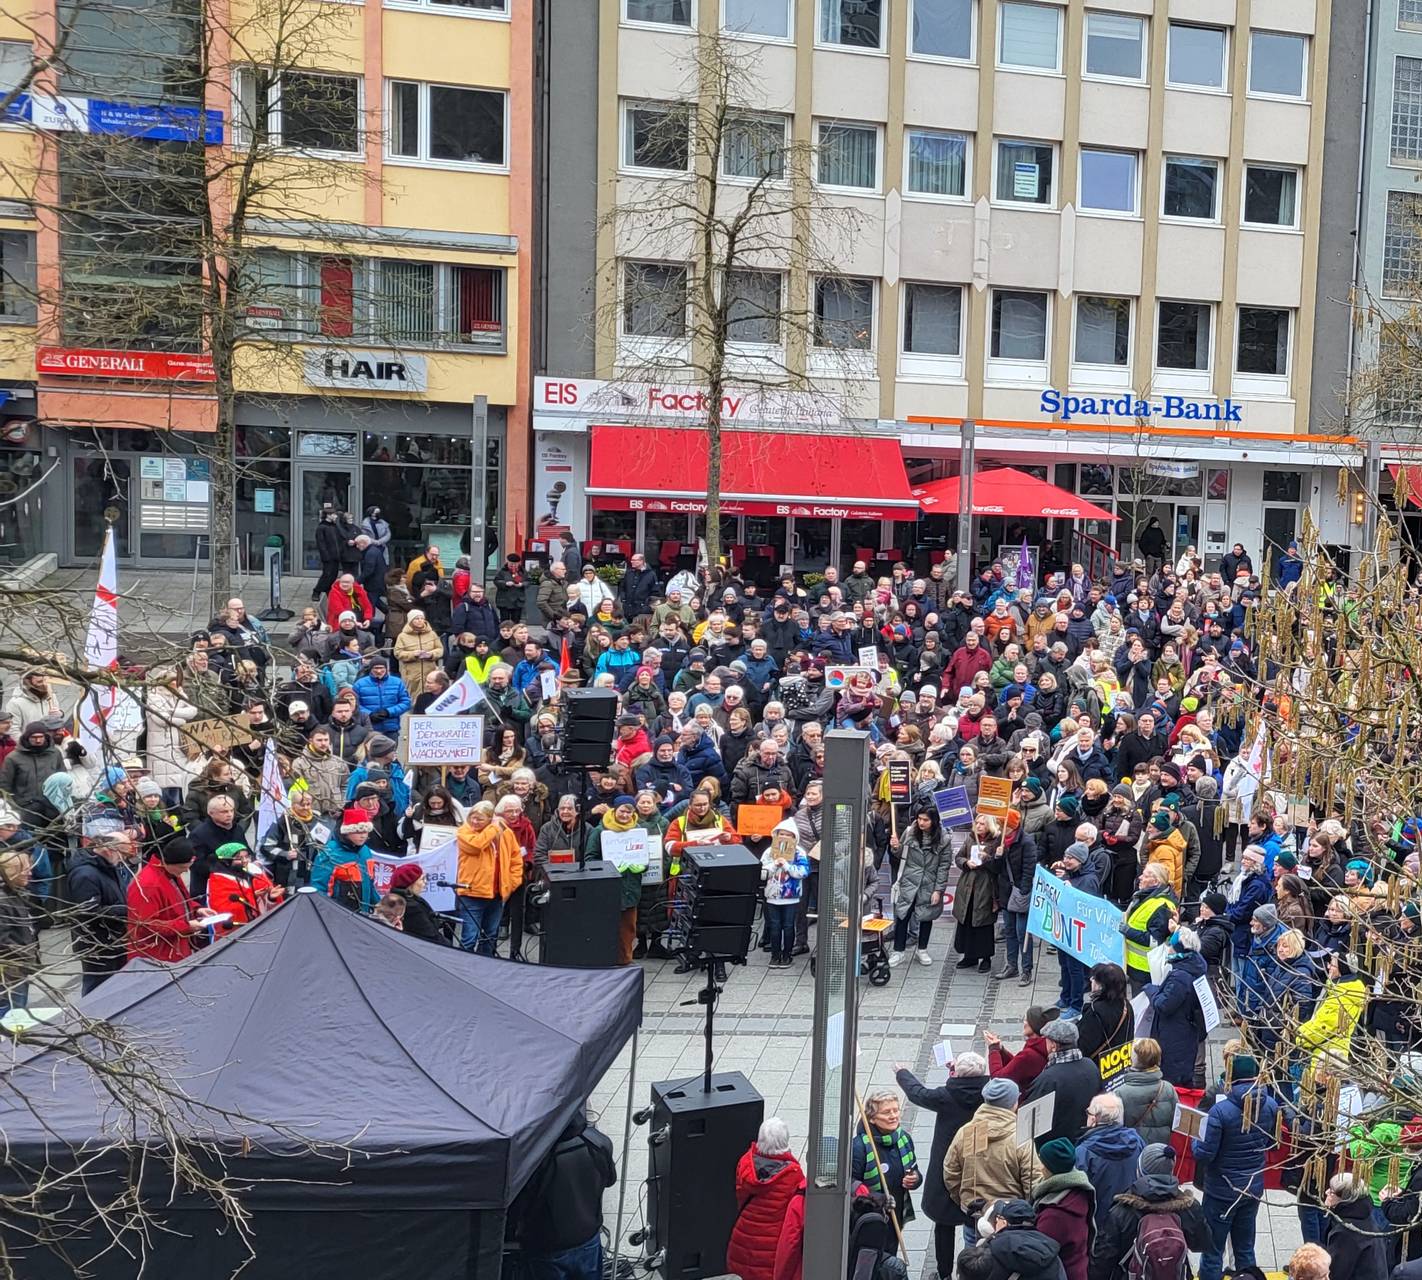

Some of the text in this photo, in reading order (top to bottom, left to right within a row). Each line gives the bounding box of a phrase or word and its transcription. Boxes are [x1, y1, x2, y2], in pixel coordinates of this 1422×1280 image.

[67, 354, 145, 371] GENERALI
[325, 358, 406, 380] HAIR
[544, 382, 577, 404] EIS
[1040, 389, 1242, 421] Sparda-Bank
[630, 500, 643, 509] EIS
[776, 505, 790, 514] EIS
[813, 506, 849, 518] Factory
[1040, 507, 1080, 516] Coca-Cola
[413, 720, 478, 731] DER DER
[414, 740, 445, 748] EWIGE
[410, 747, 476, 760] WACHSAMKEIT
[1042, 900, 1086, 952] BUNT
